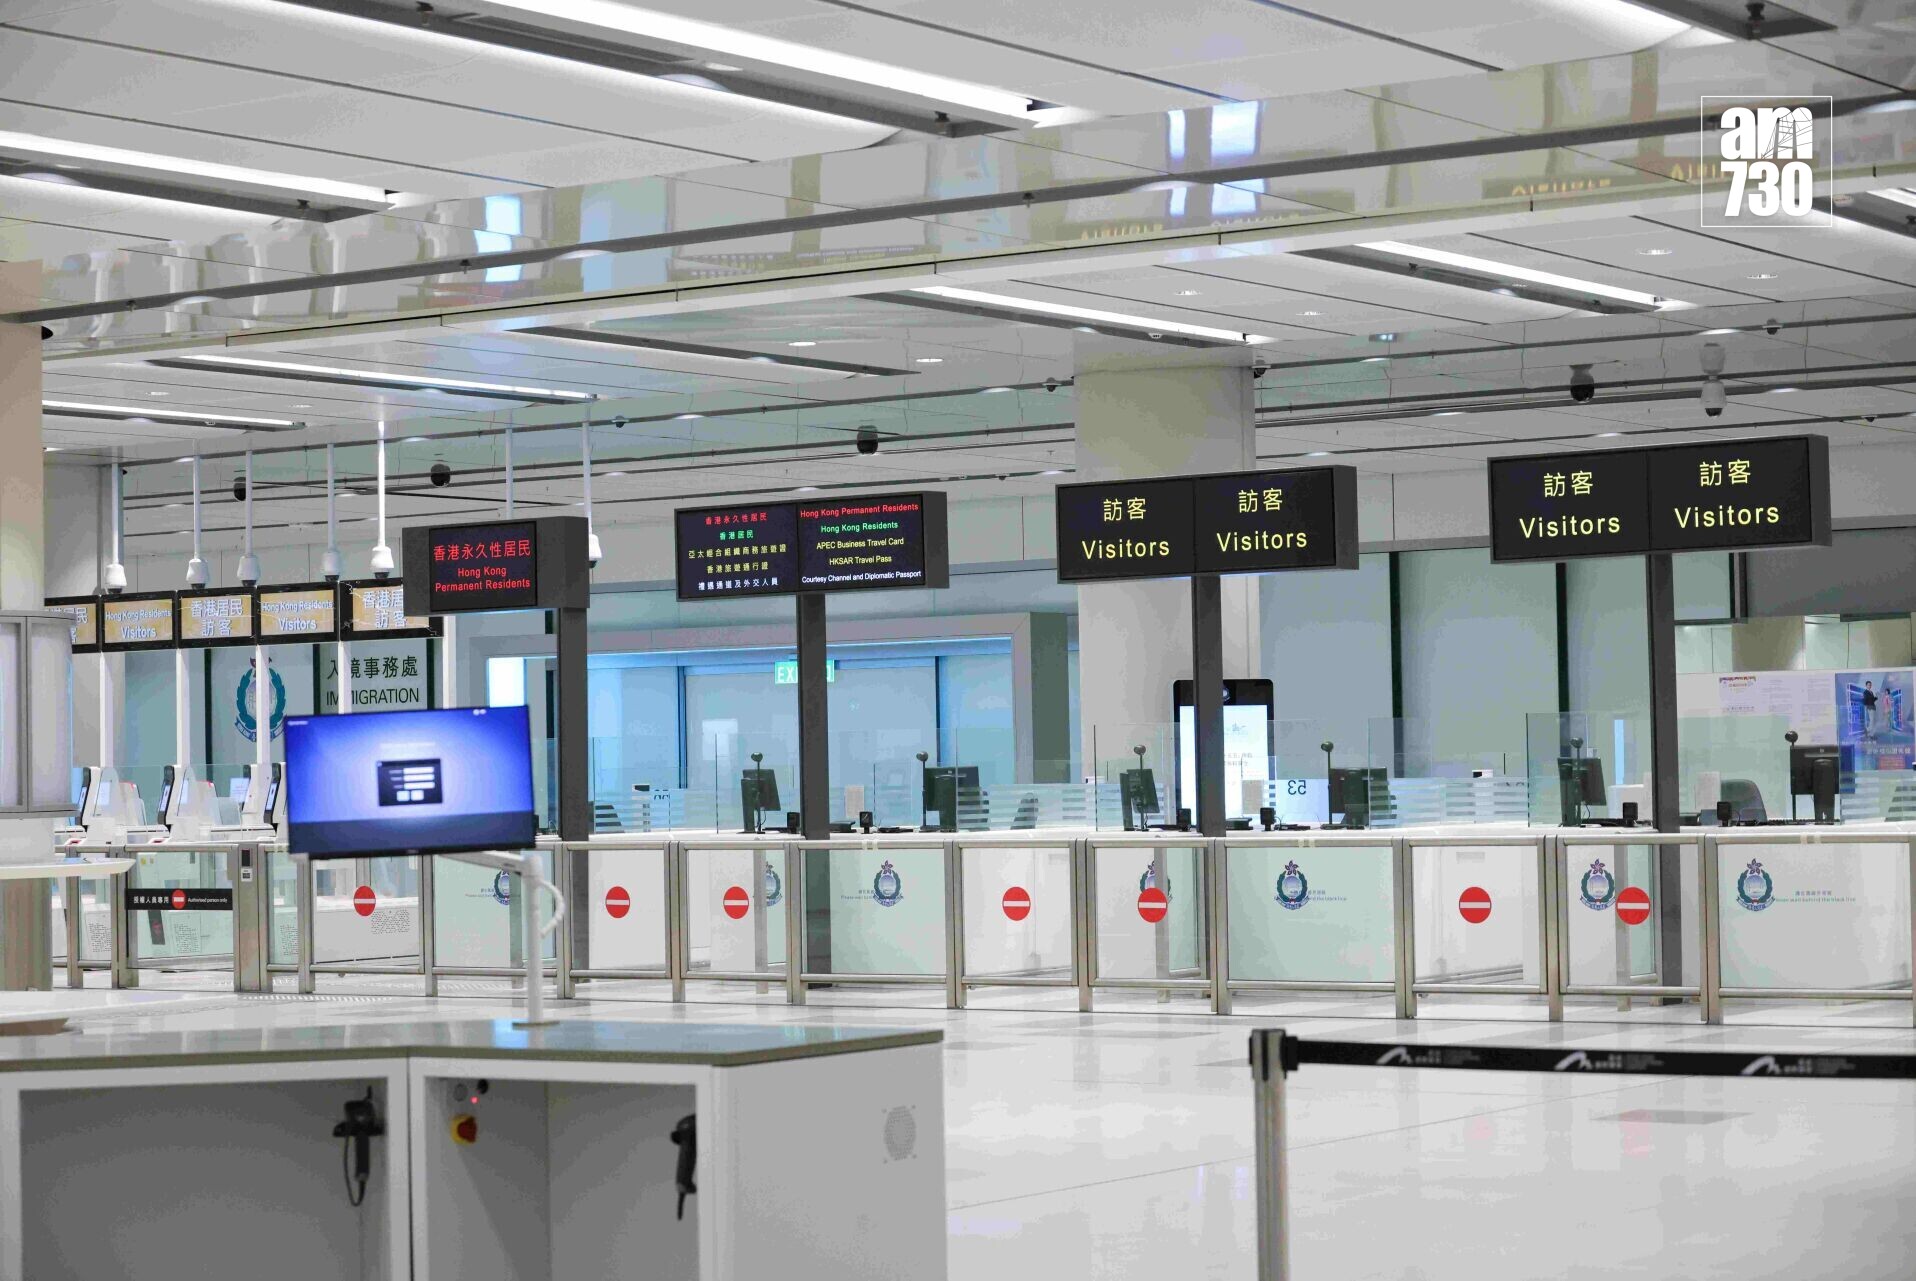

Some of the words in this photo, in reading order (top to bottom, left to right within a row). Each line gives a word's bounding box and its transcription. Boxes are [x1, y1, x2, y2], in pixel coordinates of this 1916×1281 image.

[1699, 459, 1751, 487] 訪客
[1543, 470, 1594, 498] 訪客
[1103, 497, 1147, 522] 訪客
[1237, 488, 1284, 513] 訪客
[705, 511, 768, 526] 香港永久性居民
[800, 510, 819, 518] Hong
[821, 508, 840, 517] Kong
[841, 505, 881, 515] Permanent
[882, 503, 919, 512] Residents
[1674, 504, 1780, 529] Visitors
[719, 529, 754, 541] 香港居民
[820, 525, 840, 533] Hong
[841, 523, 860, 532] Kong
[862, 521, 899, 530] Residents
[1519, 515, 1621, 539] Visitors
[433, 539, 531, 561] 香港永久性居民
[816, 540, 836, 550] APEC
[837, 540, 866, 549] Business
[867, 537, 887, 547] Travel
[888, 536, 905, 545] Card
[1081, 538, 1170, 560] Visitors
[1216, 530, 1308, 552] Visitors
[829, 556, 854, 566] HKSAR
[855, 555, 875, 565] Travel
[876, 555, 893, 563] Pass
[457, 567, 481, 578] Hong
[483, 566, 507, 577] Kong
[801, 576, 827, 584] Courtesy
[827, 573, 852, 582] Channel
[852, 573, 864, 581] and
[864, 571, 895, 581] Diplomatic
[895, 570, 922, 580] Passport
[435, 581, 483, 592] Permanent
[485, 578, 531, 590] Residents
[191, 598, 244, 618] 香港居民
[262, 602, 279, 613] Hong
[280, 601, 299, 612] Kong
[300, 599, 334, 610] Residents
[362, 590, 404, 610] 香港居
[105, 611, 122, 622] Hong
[122, 610, 139, 621] Kong
[140, 608, 172, 619] Residents
[278, 616, 317, 632] Visitors
[375, 610, 408, 629] 訪客
[120, 625, 157, 640] Visitors
[202, 618, 232, 637] 訪客
[326, 655, 418, 680] 入境事務處
